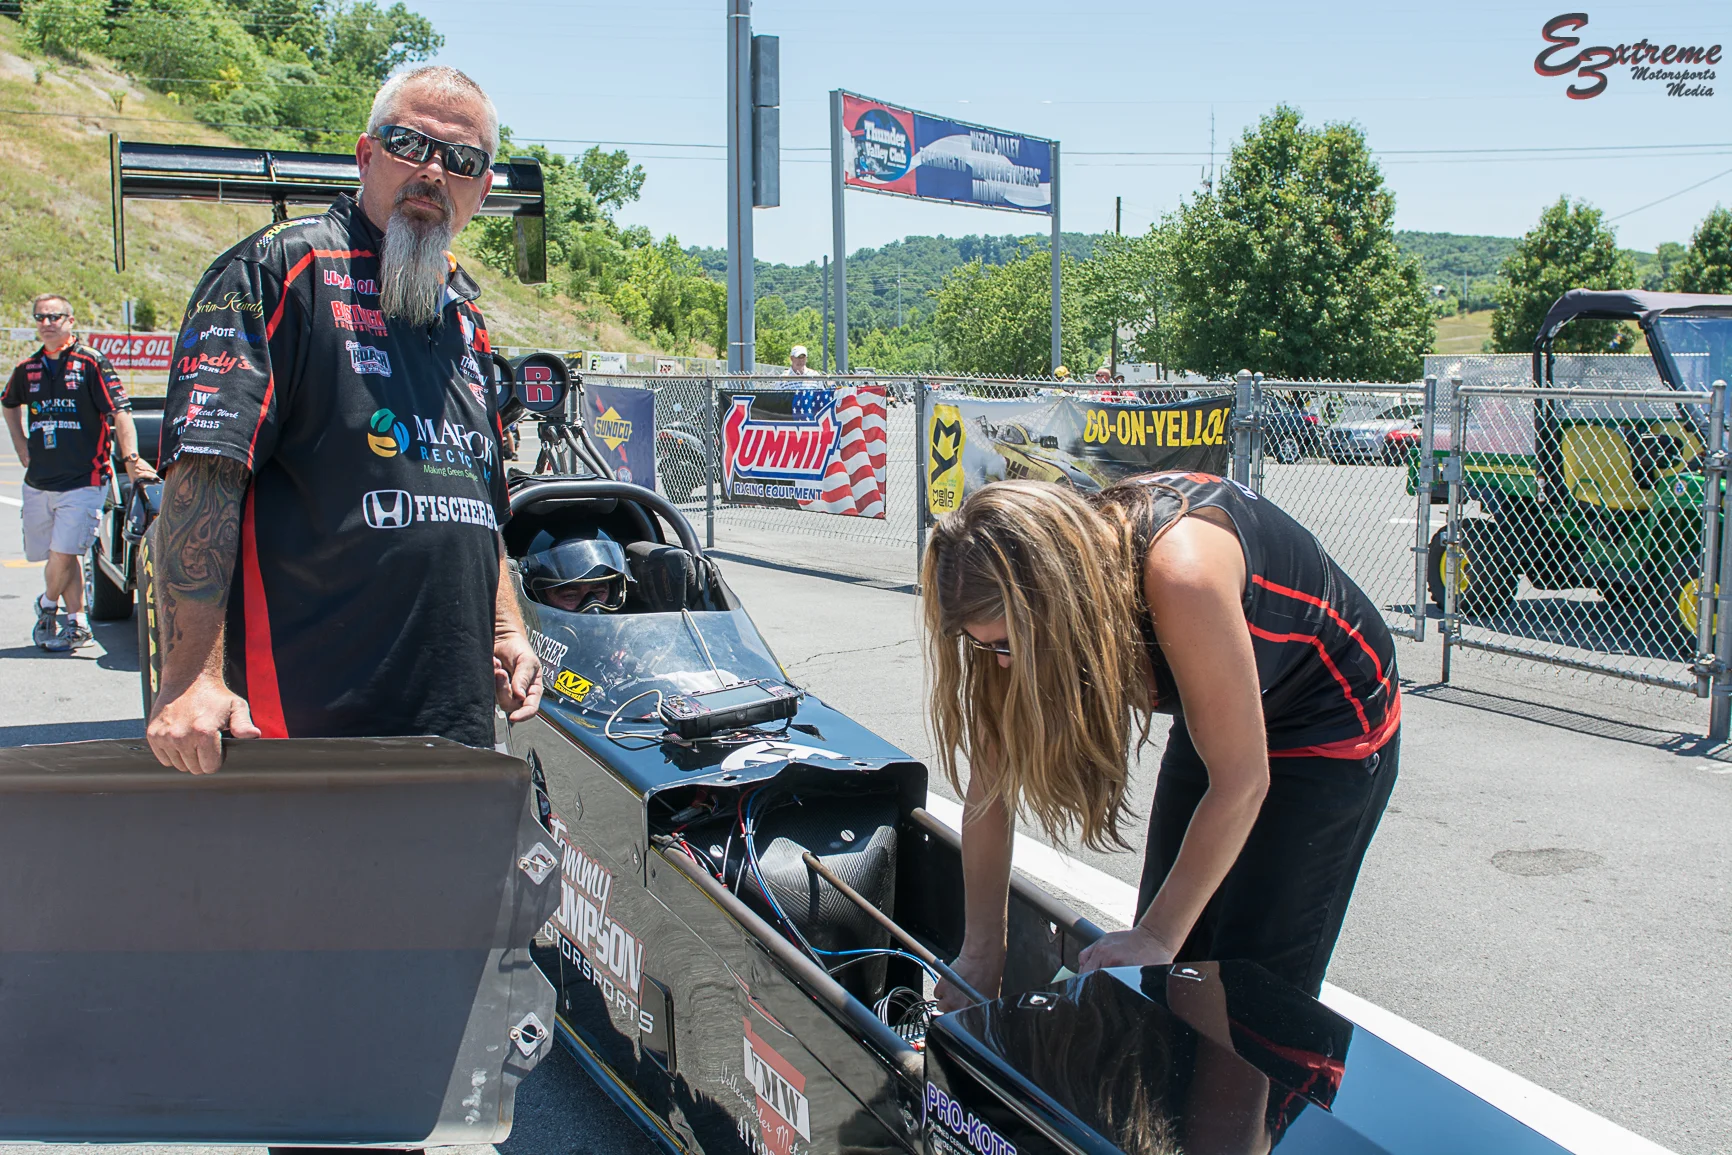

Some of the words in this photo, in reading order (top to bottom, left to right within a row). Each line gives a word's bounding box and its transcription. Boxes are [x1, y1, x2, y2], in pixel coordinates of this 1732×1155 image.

[864, 120, 906, 148] Thunder
[970, 131, 996, 155] NITRO
[997, 136, 1020, 158] ALLEY
[92, 338, 144, 356] LUCAS
[145, 339, 170, 356] OIL
[413, 415, 493, 466] MARCK
[595, 420, 630, 442] SUNOCO
[723, 398, 839, 492] SUMMIT
[423, 464, 447, 477] Making
[447, 466, 464, 477] Green
[735, 482, 764, 496] RACING
[766, 484, 822, 500] EQUIPMENT
[530, 630, 569, 667] FISCHER
[550, 817, 613, 930] Tommy
[540, 921, 654, 1034] OTORSPORTS
